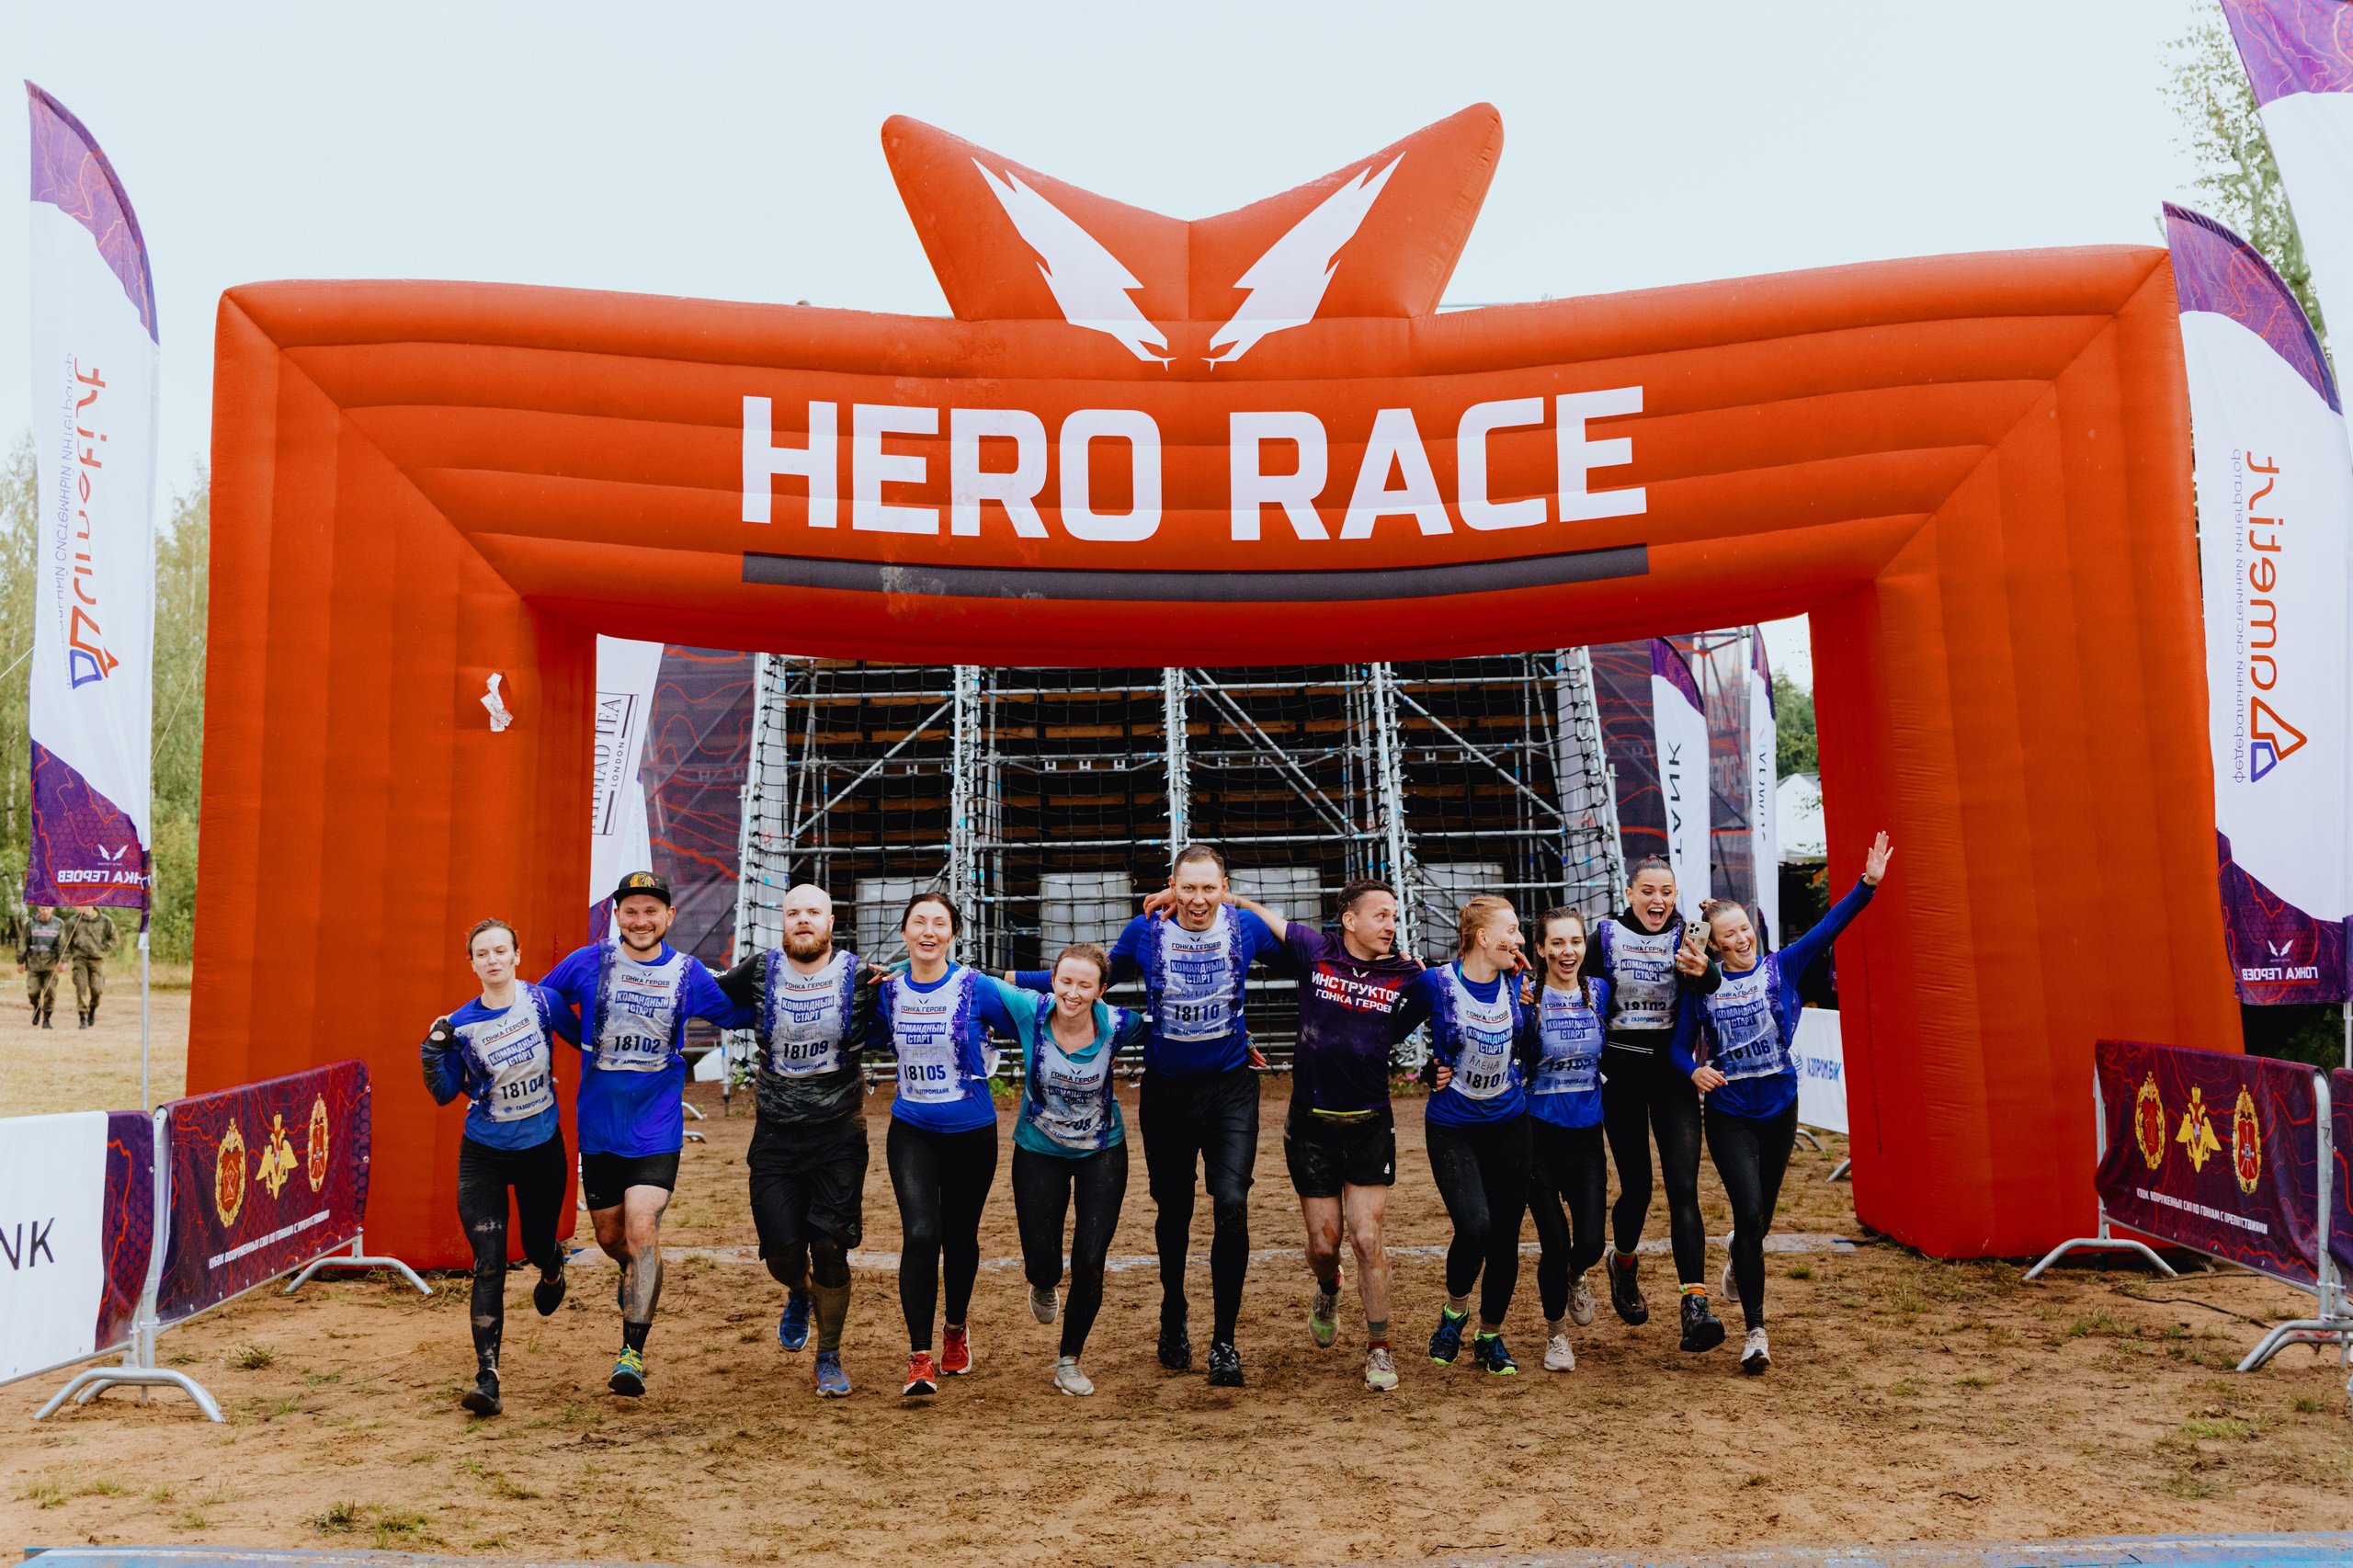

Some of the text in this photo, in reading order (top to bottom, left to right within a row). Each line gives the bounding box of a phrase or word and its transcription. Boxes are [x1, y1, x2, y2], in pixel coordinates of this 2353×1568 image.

[740, 384, 1648, 542] HERO RACE
[610, 742, 625, 787] LONDON
[1171, 941, 1222, 950] ГОНКА ГЕРОЕВ
[1171, 957, 1226, 974] КОМАНДНЫЙ
[1621, 960, 1672, 972] КОМАНДНЫЙ
[621, 974, 643, 983] ГОНКА
[1186, 974, 1211, 984] СТАРТ
[1635, 970, 1659, 981] СТАРТ
[784, 979, 833, 990] ГОНКА ГЕРОЕВ
[1312, 971, 1401, 1004] ИНСТРУКТОР
[616, 992, 671, 1008] КОМАНДНЫЙ
[782, 994, 835, 1012] КОМАНДНЫЙ
[1315, 988, 1392, 1014] ГОНКА ГЕРОЕВ
[630, 1003, 654, 1017] СТАРТ
[795, 1011, 820, 1022] СТАРТ
[901, 1005, 920, 1013] ГОНКА
[1174, 1004, 1220, 1022] 18110
[1466, 1010, 1487, 1021] ГОНКА
[1716, 998, 1764, 1020] КОМАНДНЫЙ
[897, 1021, 947, 1036] КОМАНДНЫЙ
[1547, 1017, 1596, 1030] КОМАНДНЫЙ
[1731, 1016, 1755, 1028] СТАРТ
[482, 1017, 530, 1044] ГОНКА ГЕРОЕВ
[1562, 1029, 1585, 1040] СТАРТ
[614, 1035, 661, 1055] 18102
[907, 1034, 932, 1044] СТАРТ
[489, 1031, 541, 1065] КОМАНДНЫЙ
[783, 1040, 829, 1060] 18109
[1480, 1042, 1503, 1054] СТАРТ
[1726, 1039, 1771, 1062] 18106
[508, 1049, 534, 1066] СТАРТ
[1469, 1055, 1500, 1072] АЛЕНА
[904, 1063, 947, 1081] 18105
[1051, 1071, 1100, 1083] ГОНКА ГЕРОЕВ
[1465, 1070, 1506, 1090] 18101
[500, 1074, 545, 1100] 18104
